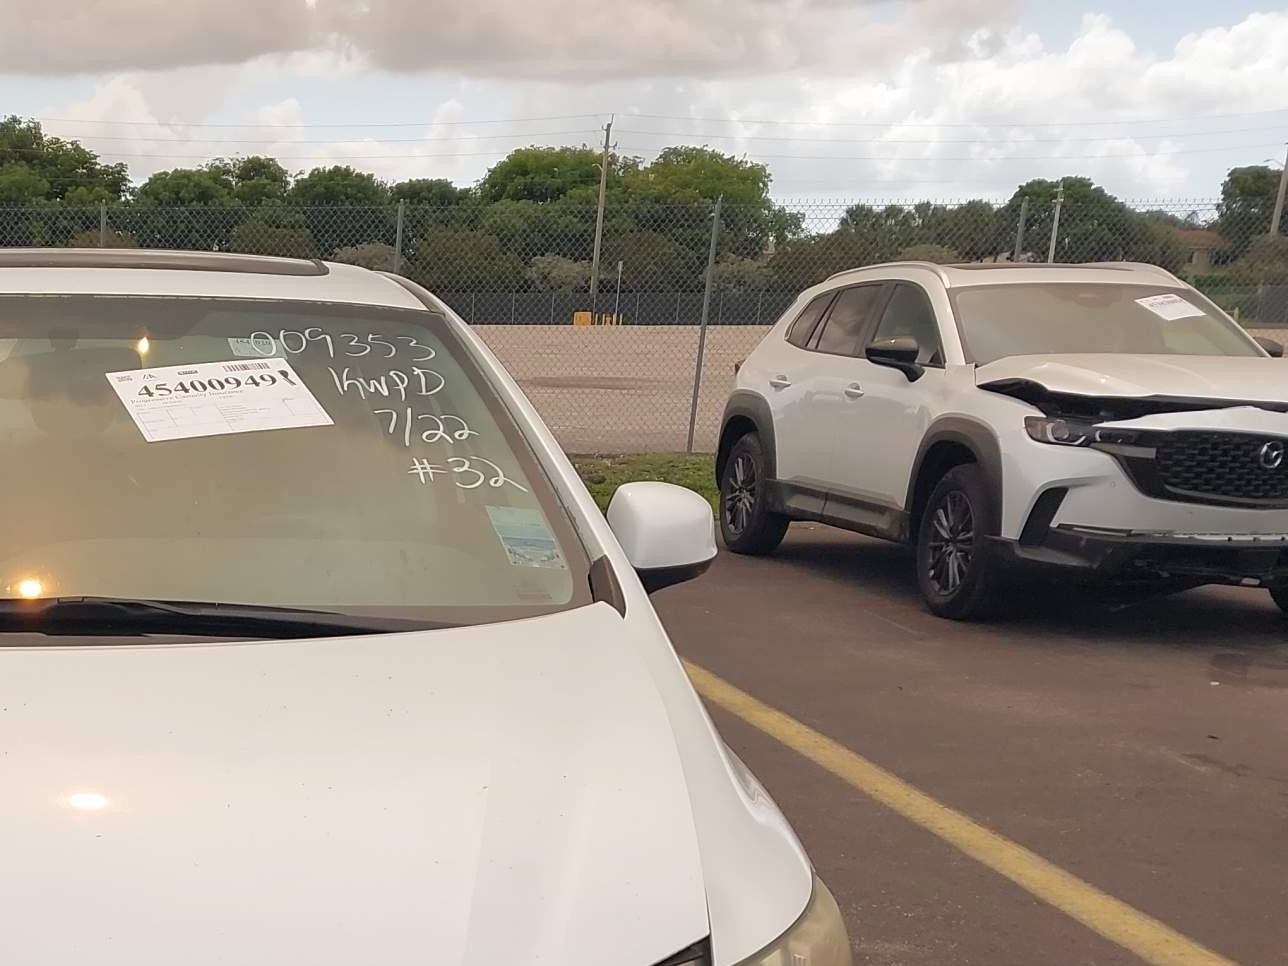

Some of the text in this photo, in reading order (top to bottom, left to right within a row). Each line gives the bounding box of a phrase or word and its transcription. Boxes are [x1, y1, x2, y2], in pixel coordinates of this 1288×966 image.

[249, 328, 436, 360] 009353
[137, 373, 277, 397] 45400949
[373, 407, 480, 446] 7/22
[408, 456, 528, 492] #32
